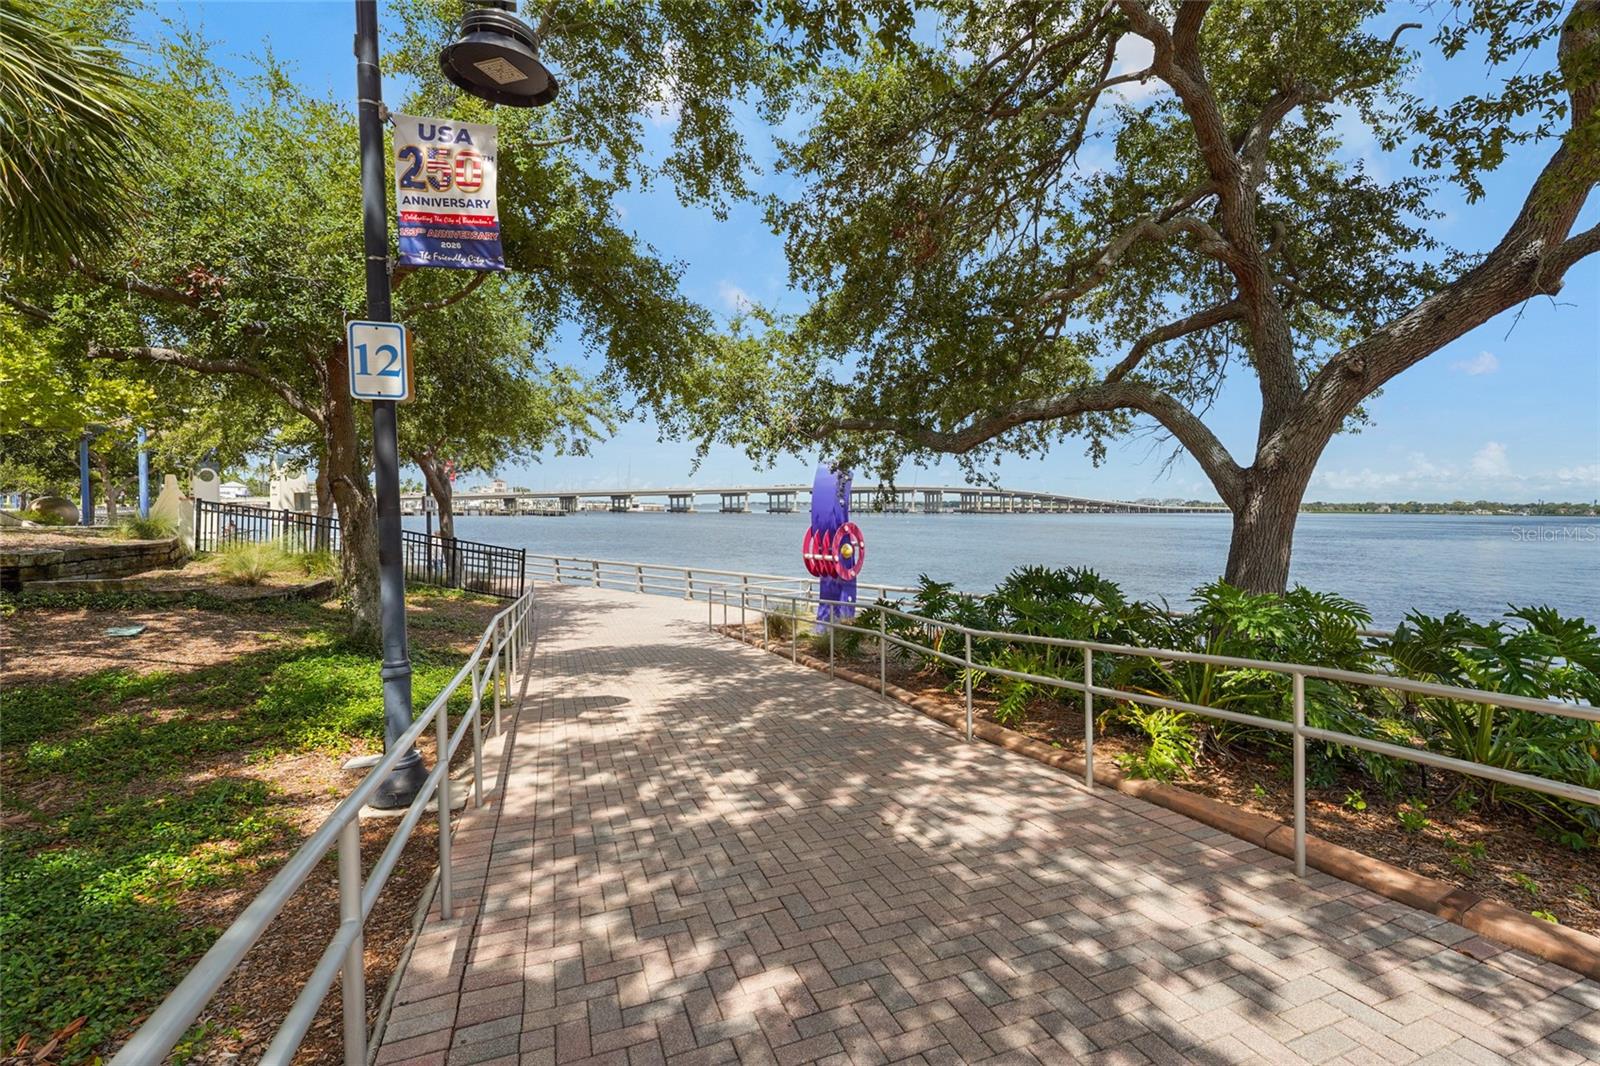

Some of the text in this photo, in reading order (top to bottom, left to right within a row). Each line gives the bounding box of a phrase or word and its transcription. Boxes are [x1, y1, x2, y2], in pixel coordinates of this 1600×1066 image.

[418, 123, 474, 145] USA
[402, 196, 491, 209] ANNIVERSARY
[427, 229, 498, 240] ANNIVERSARY
[419, 251, 485, 265] The Friendly City
[354, 343, 401, 377] 12
